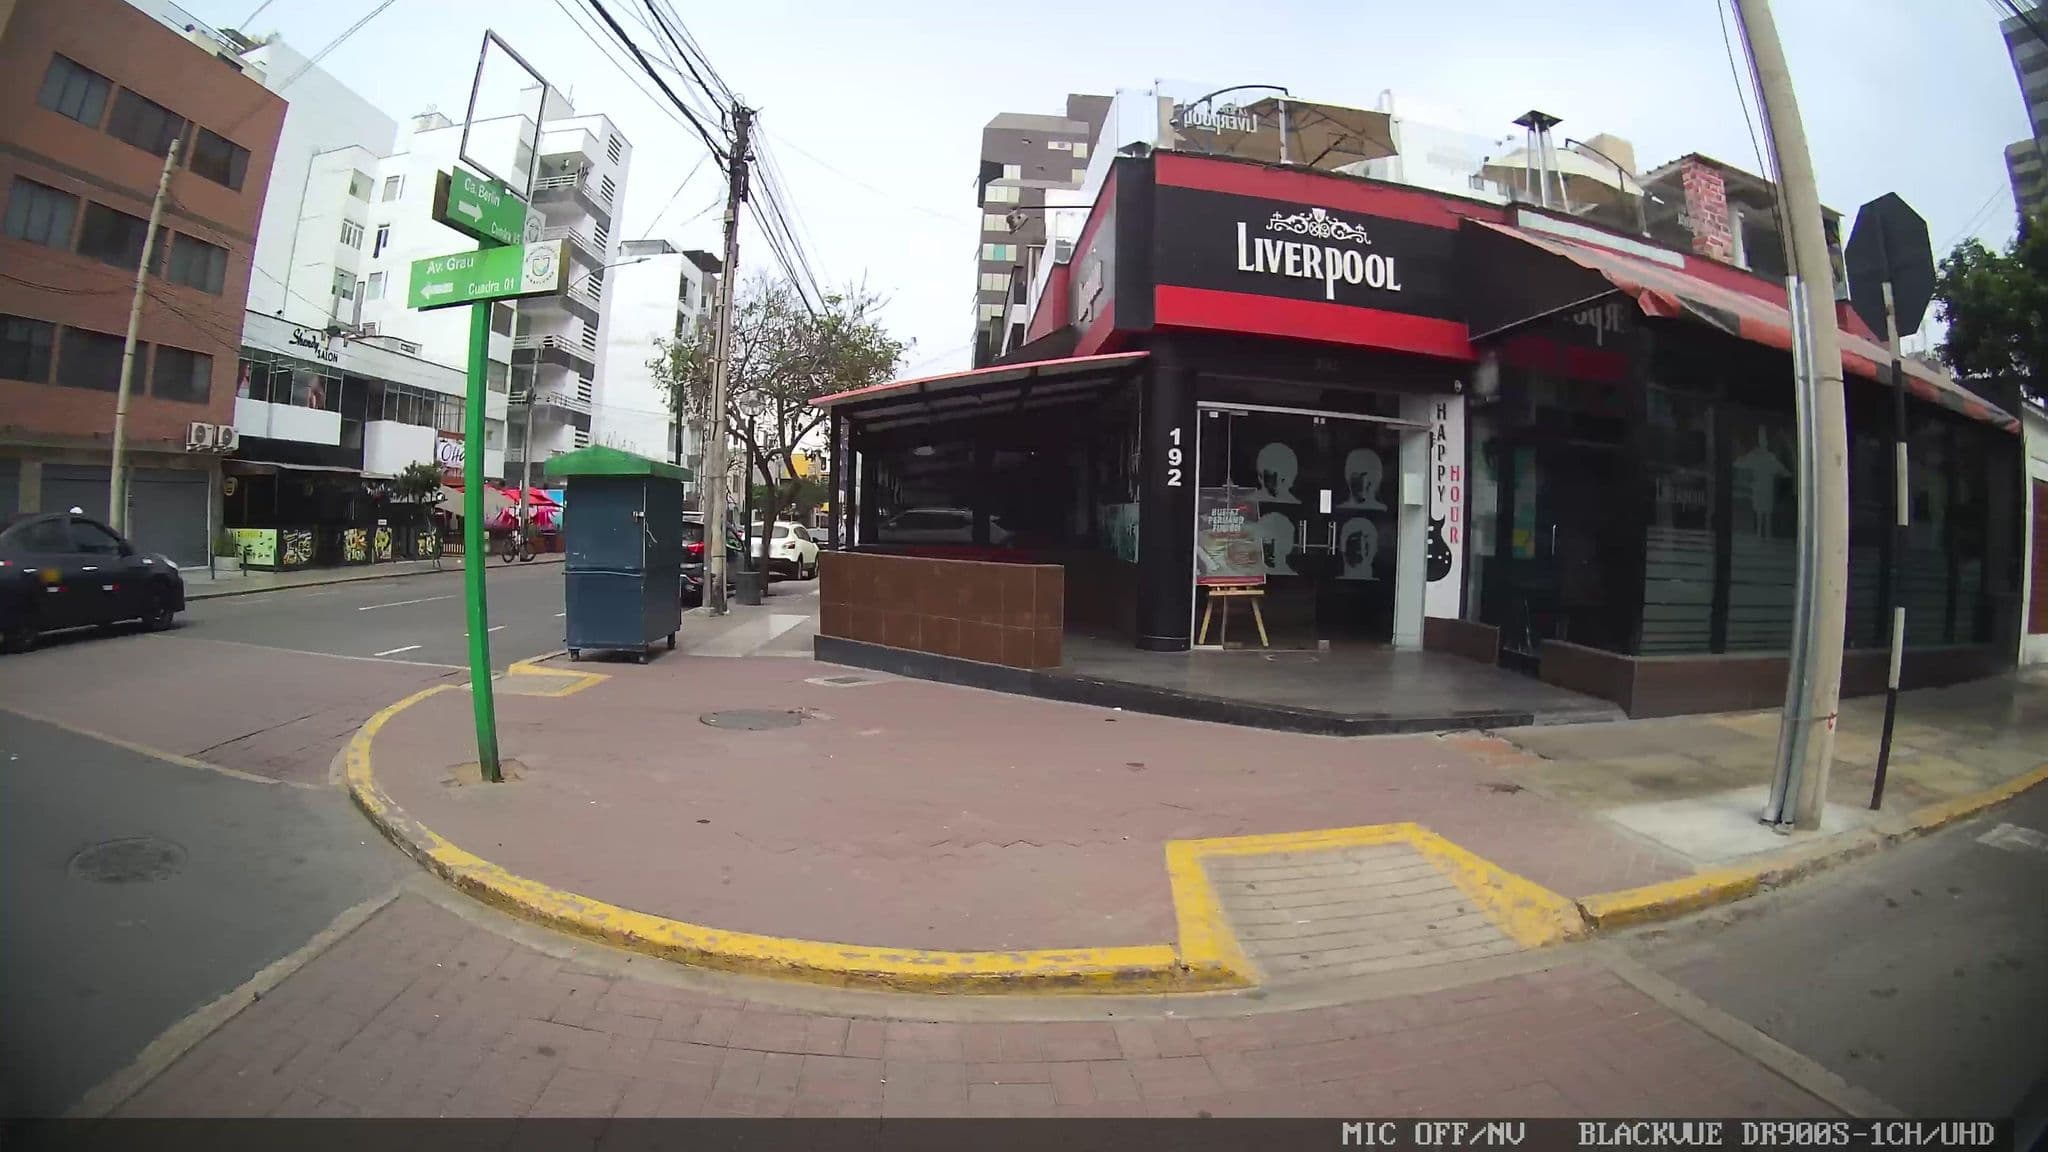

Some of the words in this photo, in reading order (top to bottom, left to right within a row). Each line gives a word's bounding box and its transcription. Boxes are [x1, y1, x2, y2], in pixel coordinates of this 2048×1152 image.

[478, 185, 500, 208] Berlin
[426, 261, 443, 275] Av.
[446, 257, 474, 271] Grau
[1237, 221, 1401, 300] LIVERPOOL
[468, 281, 500, 296] Cuadra
[504, 278, 514, 291] 01
[317, 349, 338, 363] SALON
[1167, 427, 1183, 487] 192
[1436, 402, 1447, 502] HAPPY
[1449, 465, 1460, 544] HOUR
